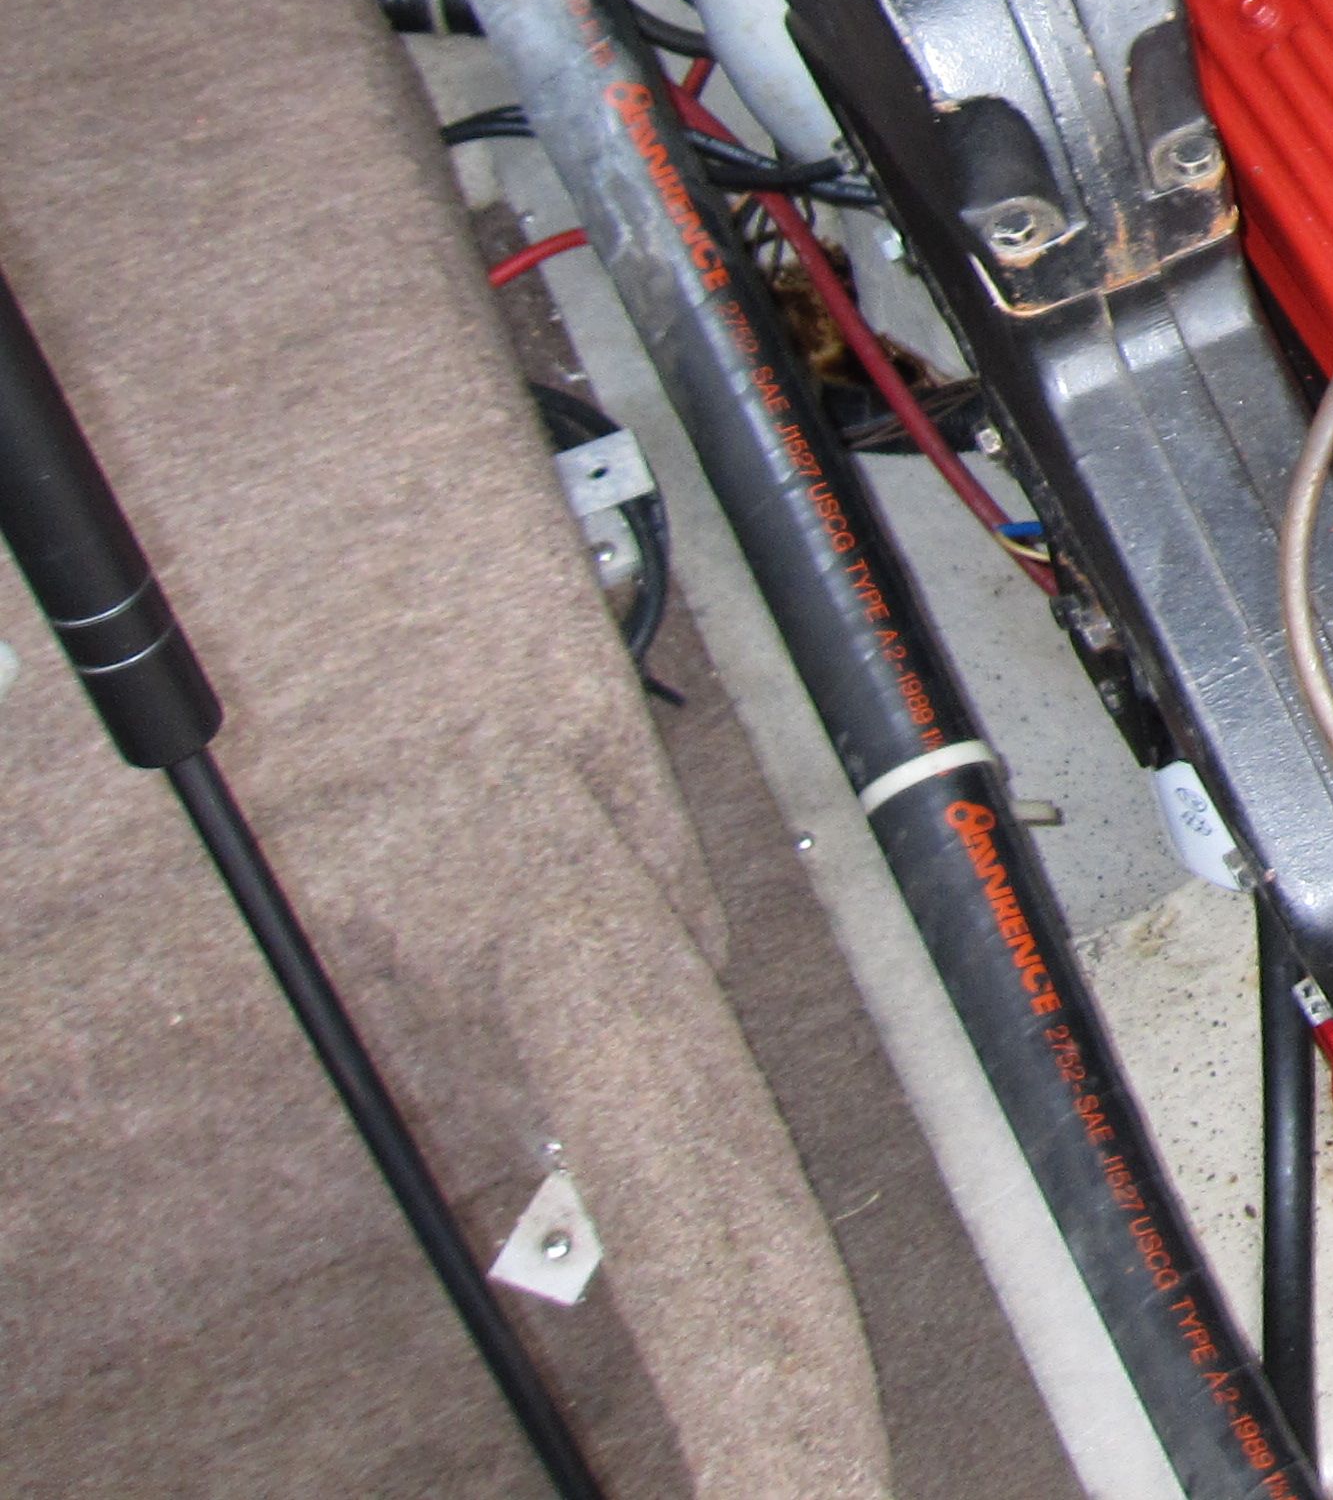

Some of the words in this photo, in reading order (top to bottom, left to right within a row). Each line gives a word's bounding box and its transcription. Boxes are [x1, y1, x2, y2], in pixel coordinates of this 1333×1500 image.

[612, 92, 732, 291] LAWRENCE
[806, 481, 857, 555] USCG
[845, 558, 891, 624] TYPE
[951, 814, 1063, 1017] LAWRENCE
[1128, 1215, 1183, 1293] USCG
[1169, 1296, 1220, 1366] TYPE
